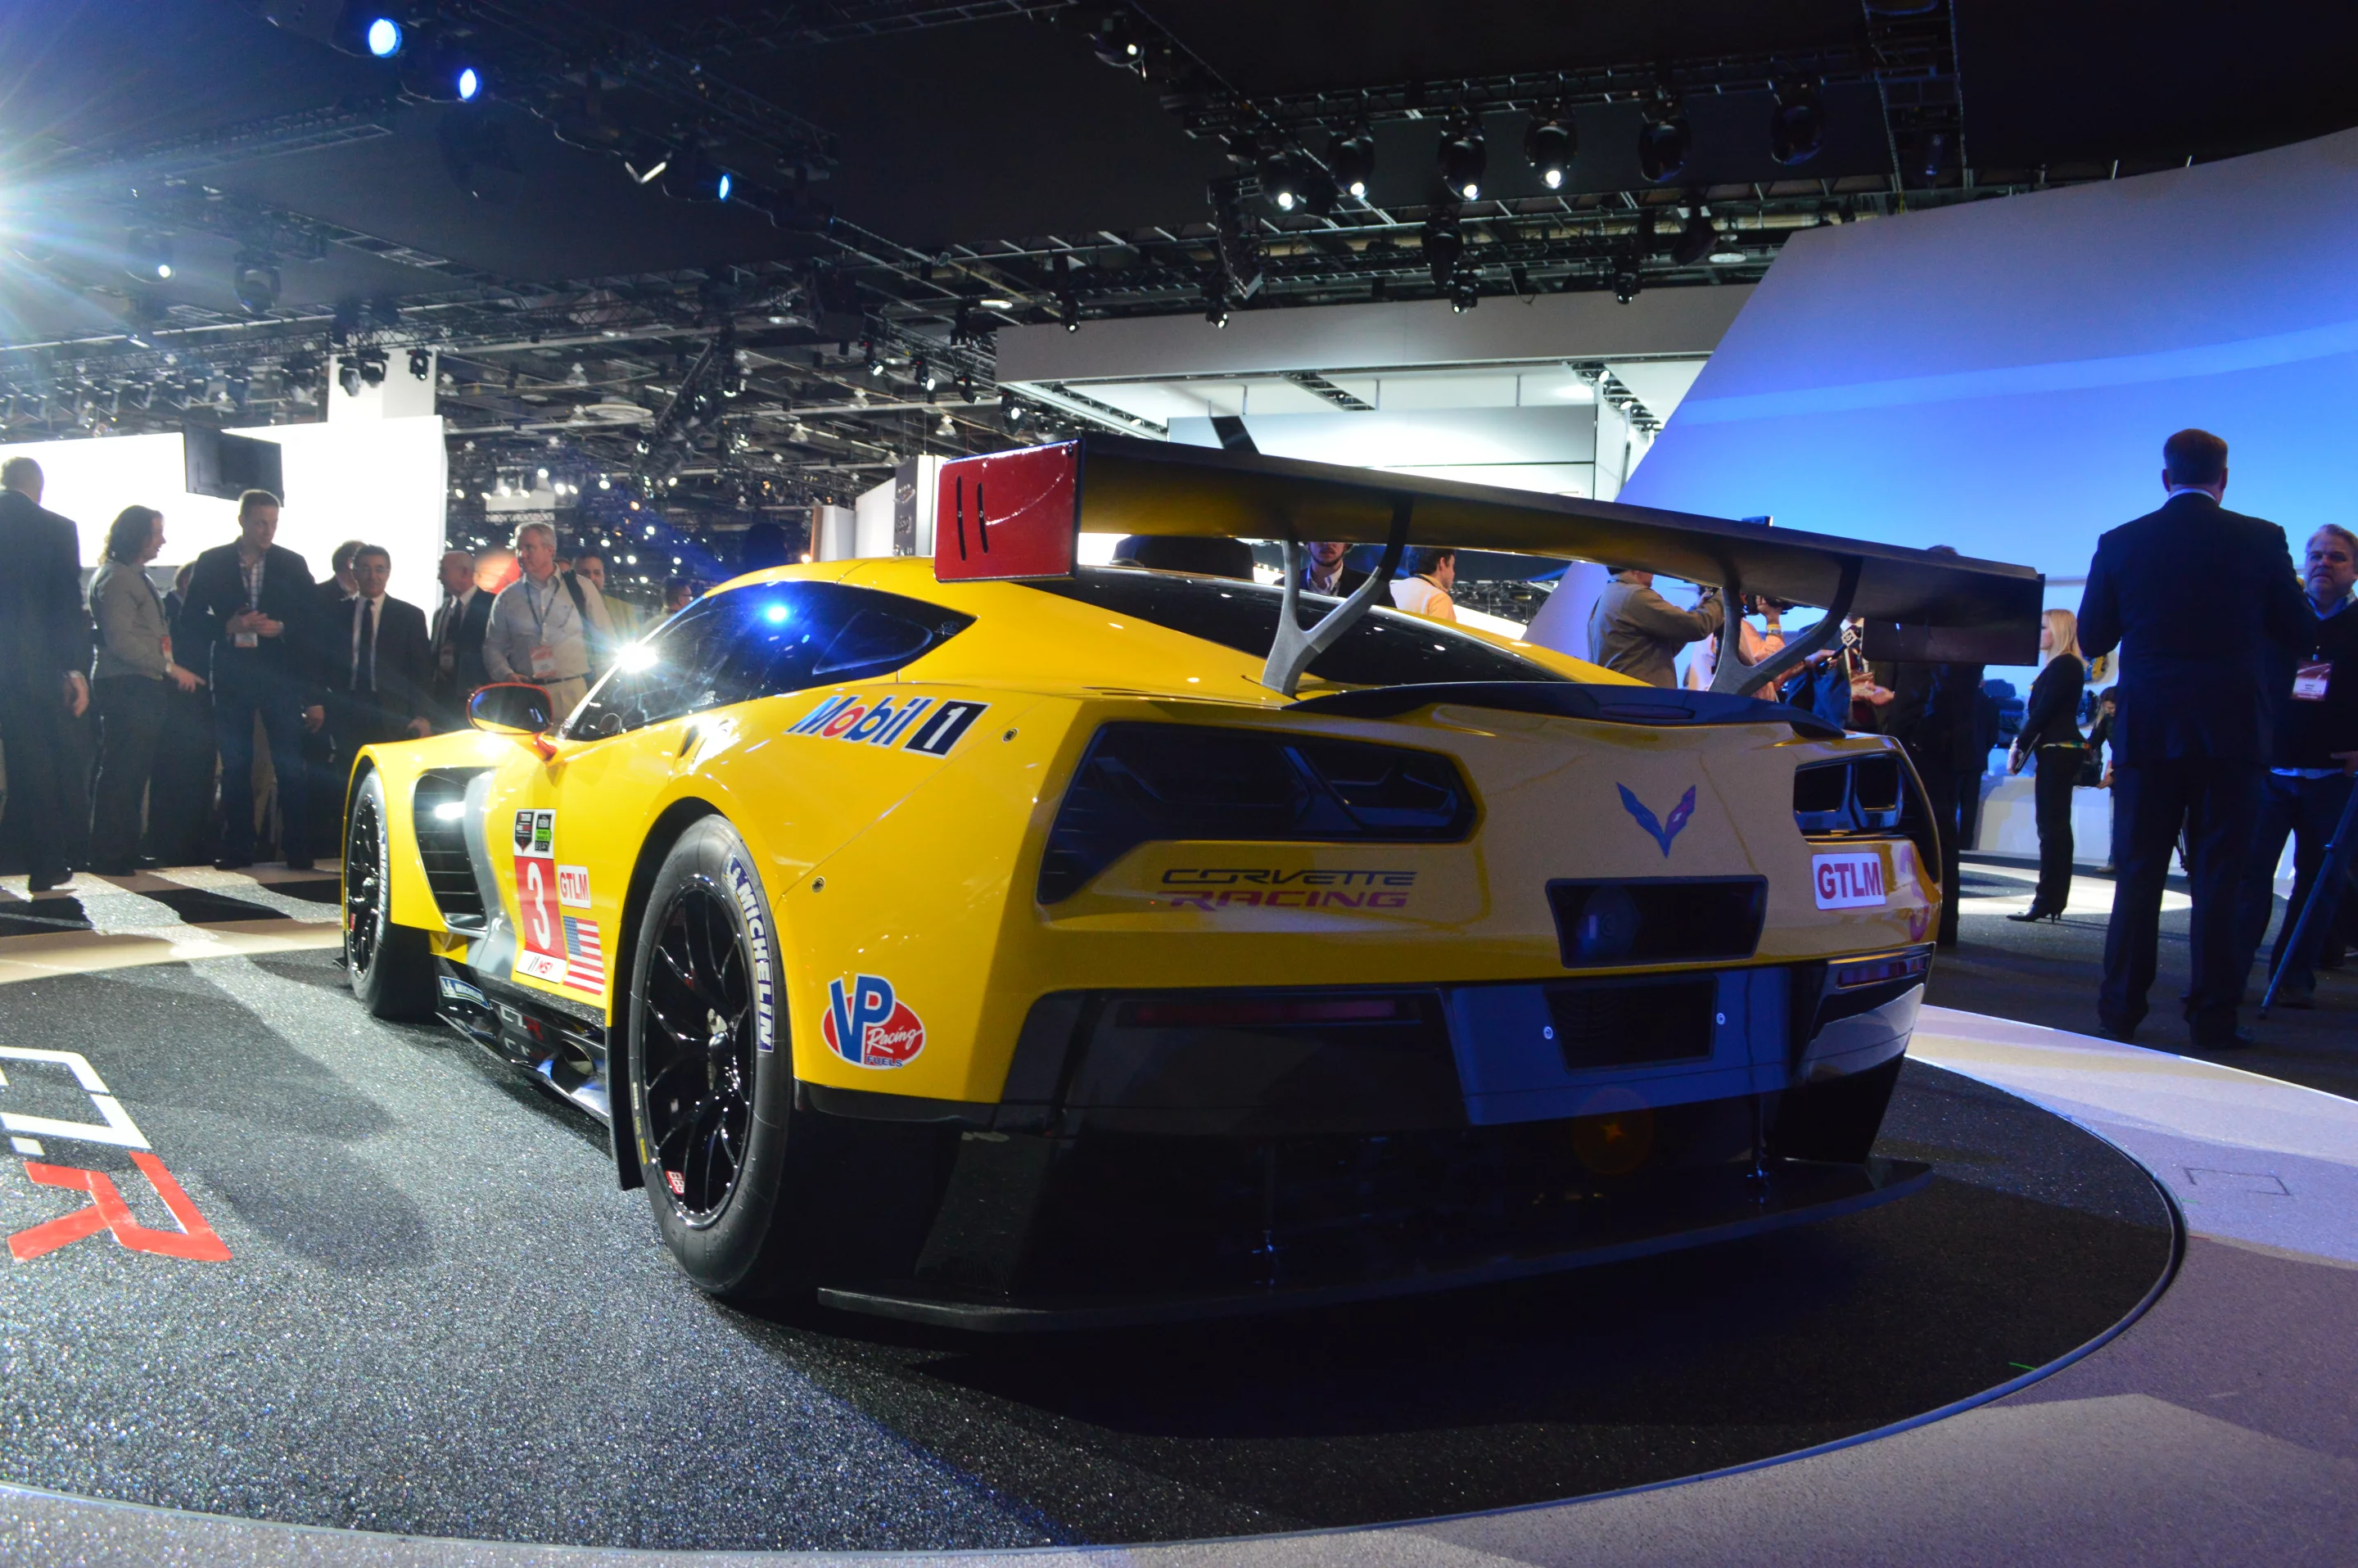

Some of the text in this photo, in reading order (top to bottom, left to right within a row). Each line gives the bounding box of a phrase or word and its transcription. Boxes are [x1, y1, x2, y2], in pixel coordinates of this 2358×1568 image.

[784, 695, 936, 748] Mobil
[559, 871, 590, 901] GTLM
[1162, 869, 1418, 886] CORVETTE
[1817, 861, 1883, 901] GTLM
[526, 861, 552, 951] 3
[1157, 889, 1410, 911] RACING
[736, 881, 774, 1047] MICHELIN
[829, 974, 896, 1065] VP
[866, 1025, 924, 1055] Racing
[865, 1055, 903, 1068] FUELS
